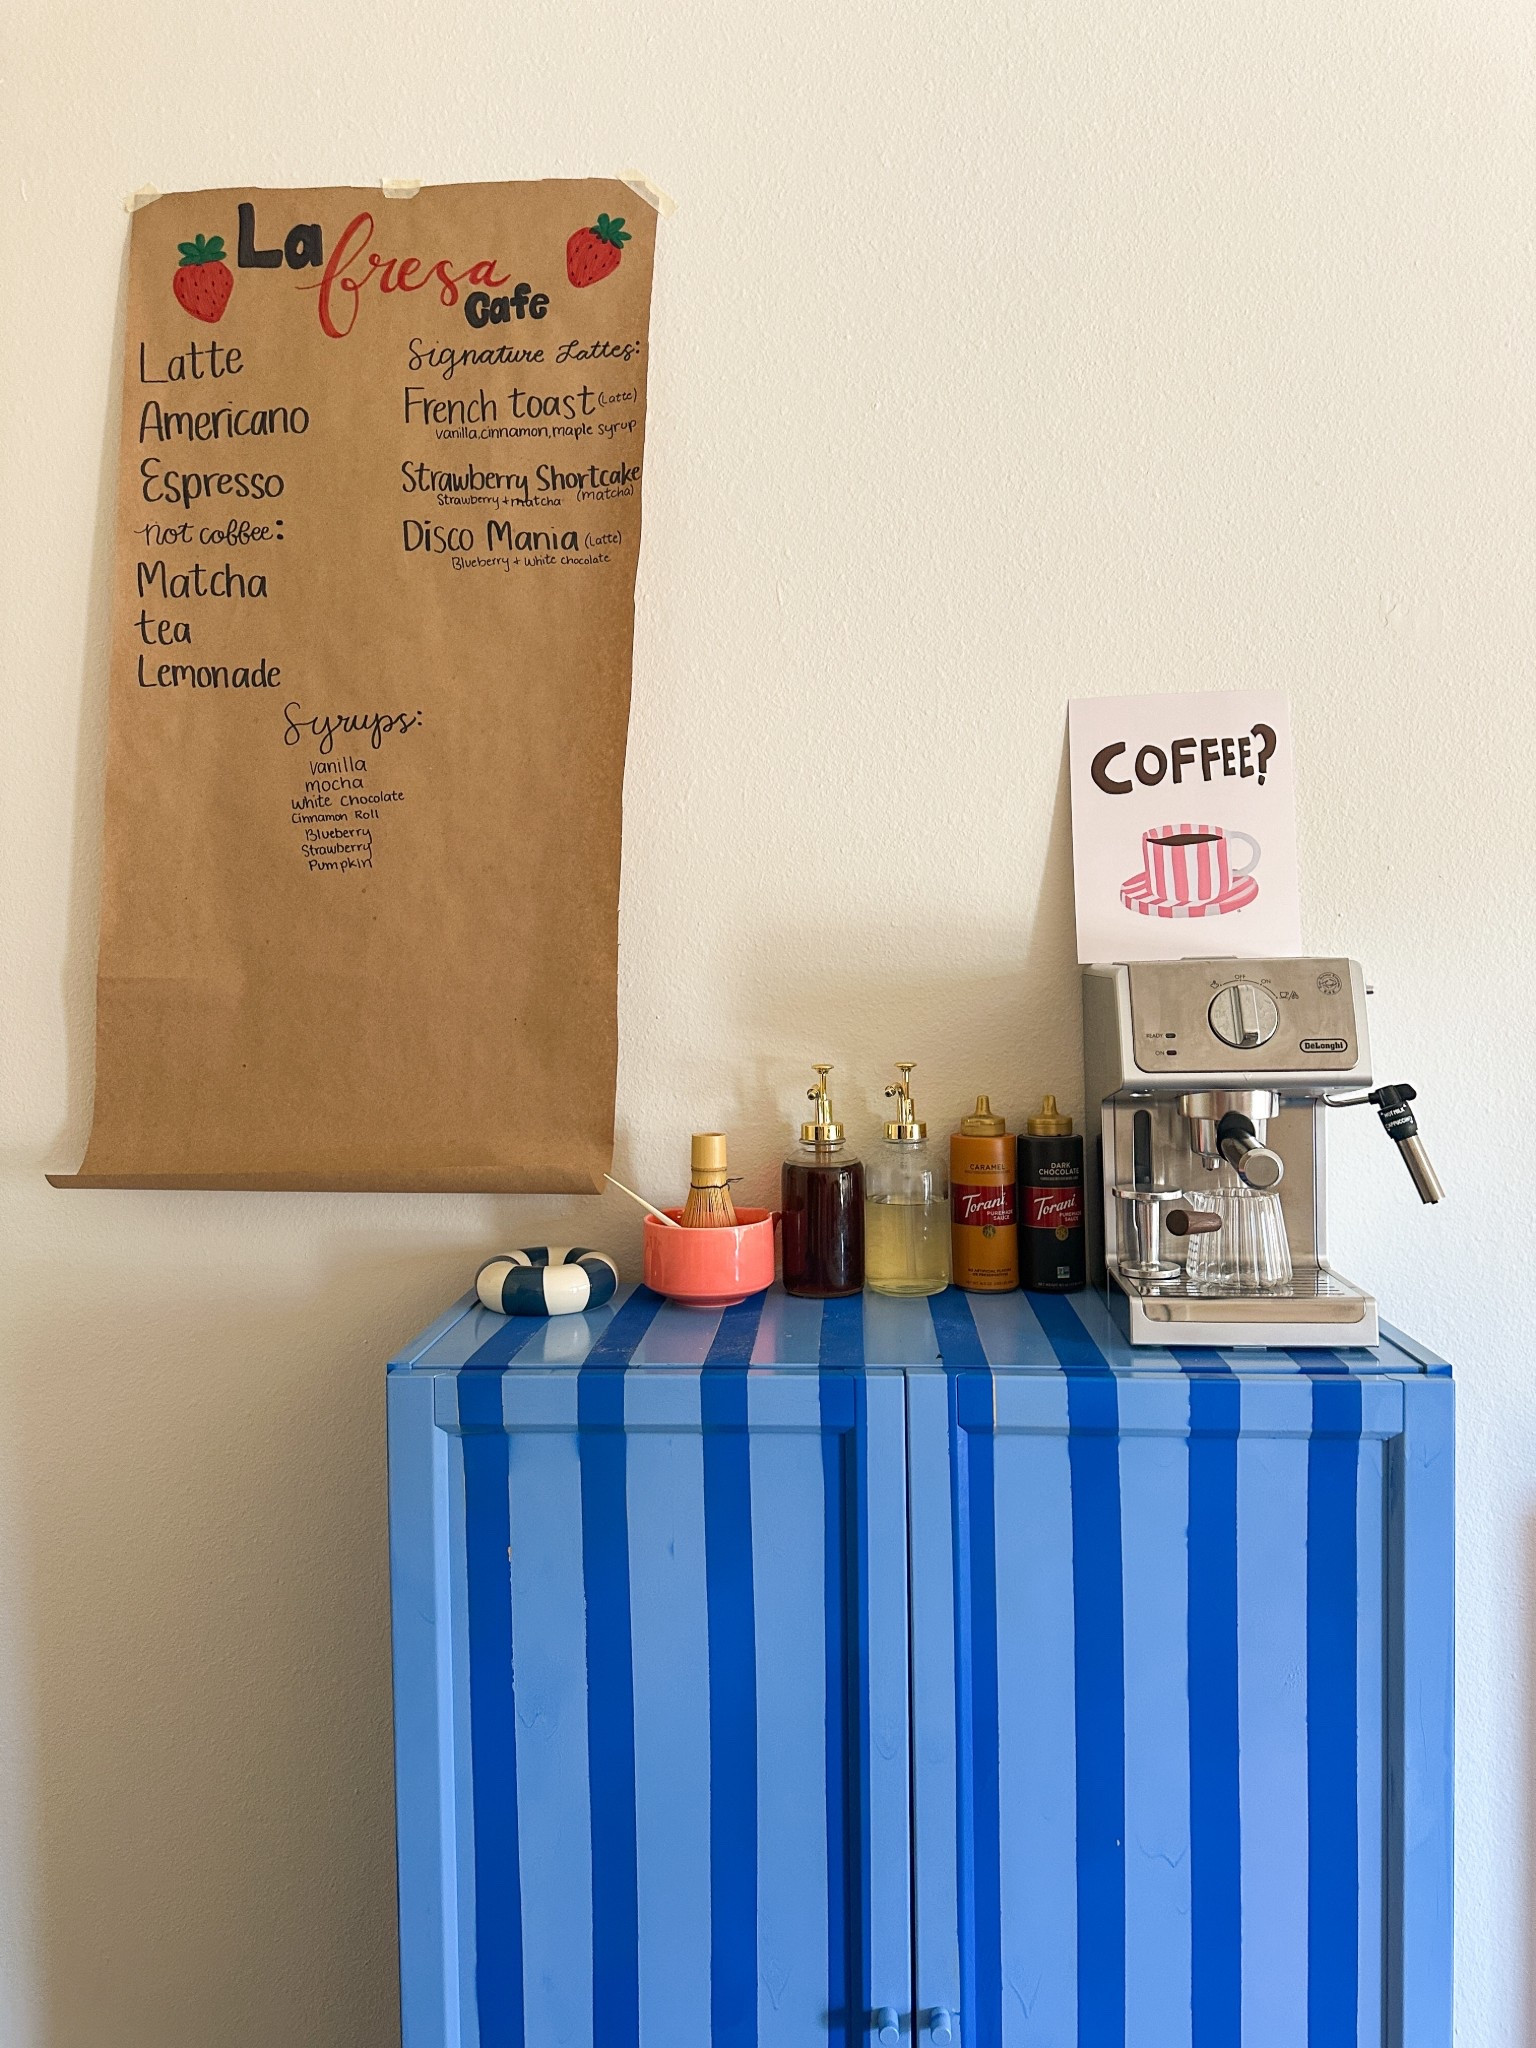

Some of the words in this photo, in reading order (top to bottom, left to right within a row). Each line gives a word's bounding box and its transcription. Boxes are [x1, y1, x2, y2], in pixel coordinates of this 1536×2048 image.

[238, 202, 324, 270] La
[294, 212, 512, 339] fresa
[464, 282, 550, 329] Cafe
[140, 340, 244, 383] Latte
[408, 337, 544, 381] Signature
[555, 339, 641, 364] Lattes:
[139, 400, 309, 443] Americano
[404, 386, 497, 424] French
[508, 385, 597, 420] toast
[598, 419, 637, 440] syrup
[140, 457, 285, 509] Espresso
[401, 460, 529, 502] Strawberry
[535, 461, 643, 492] Shortcake
[134, 521, 194, 546] not
[200, 519, 285, 546] coffee:
[403, 519, 474, 553] Disco
[487, 520, 579, 552] Mania
[137, 560, 268, 599] Matcha
[452, 556, 510, 573] Blueberry
[133, 609, 192, 646] tea
[137, 654, 282, 689] Lemonade
[284, 701, 423, 754] Syrups:
[1090, 723, 1277, 795] COFFEE?
[291, 812, 348, 824] Cinnamon
[354, 809, 380, 821] Roll
[301, 841, 373, 860] Strawberry
[305, 827, 373, 845] Blueberry
[308, 857, 373, 874] Pumpkin
[969, 1163, 1006, 1171] CARAMEL
[1038, 1168, 1080, 1176] CHOCOLATE
[962, 1192, 1007, 1218] Torani
[1033, 1193, 1076, 1220] Torani
